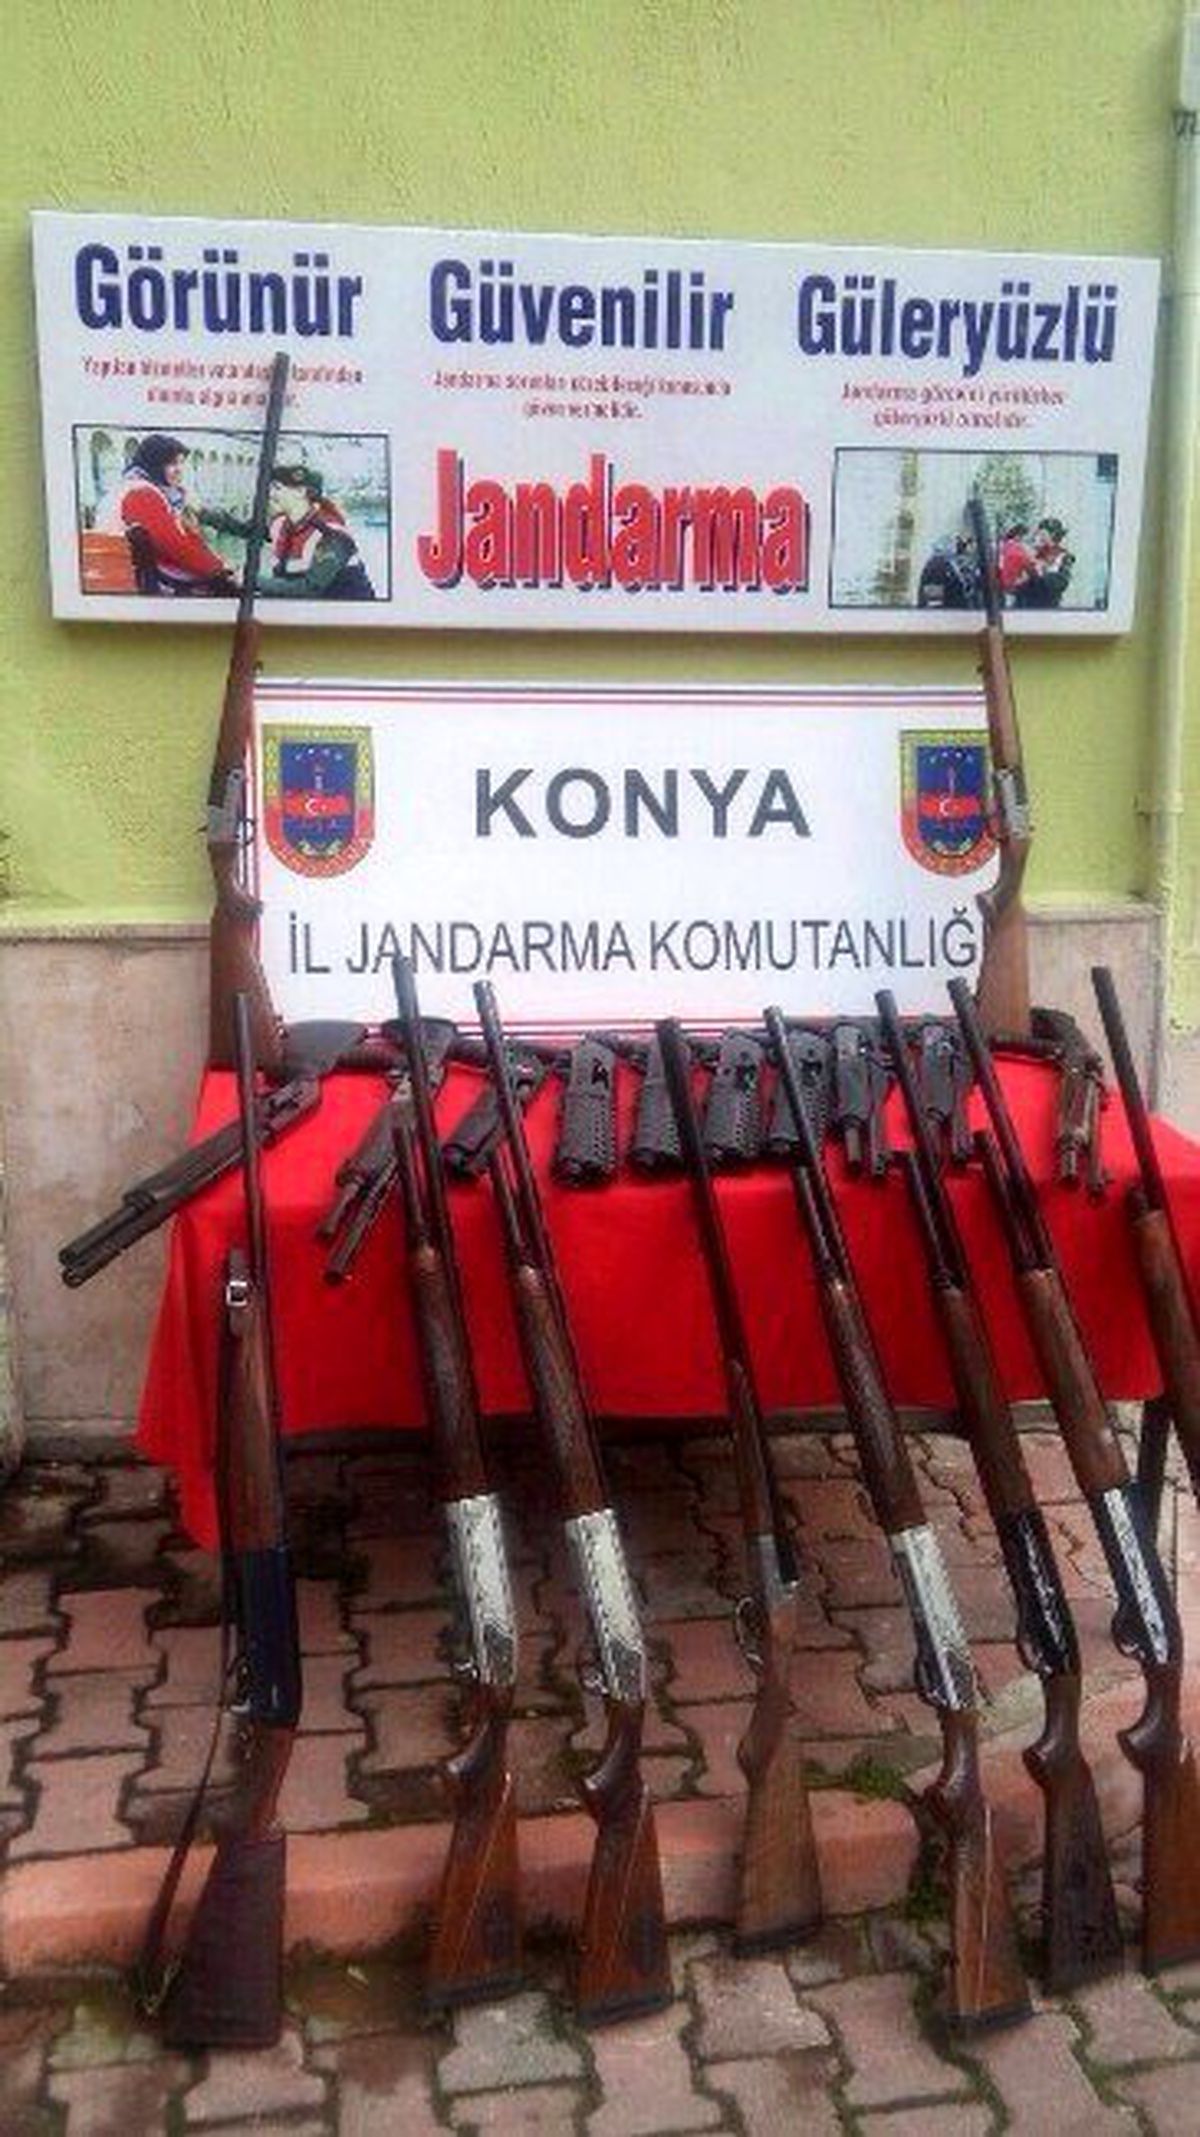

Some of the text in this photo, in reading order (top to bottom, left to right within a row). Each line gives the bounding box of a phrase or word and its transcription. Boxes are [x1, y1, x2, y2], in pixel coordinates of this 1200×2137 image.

[75, 243, 363, 337] Görünür
[429, 259, 735, 351] Güvenilir
[799, 274, 1118, 377] Güleryüzlü
[417, 448, 810, 594] Jandarma
[476, 768, 811, 839] KONYA
[289, 906, 978, 975] İL JANDARMA KOMUTANLIĞ
